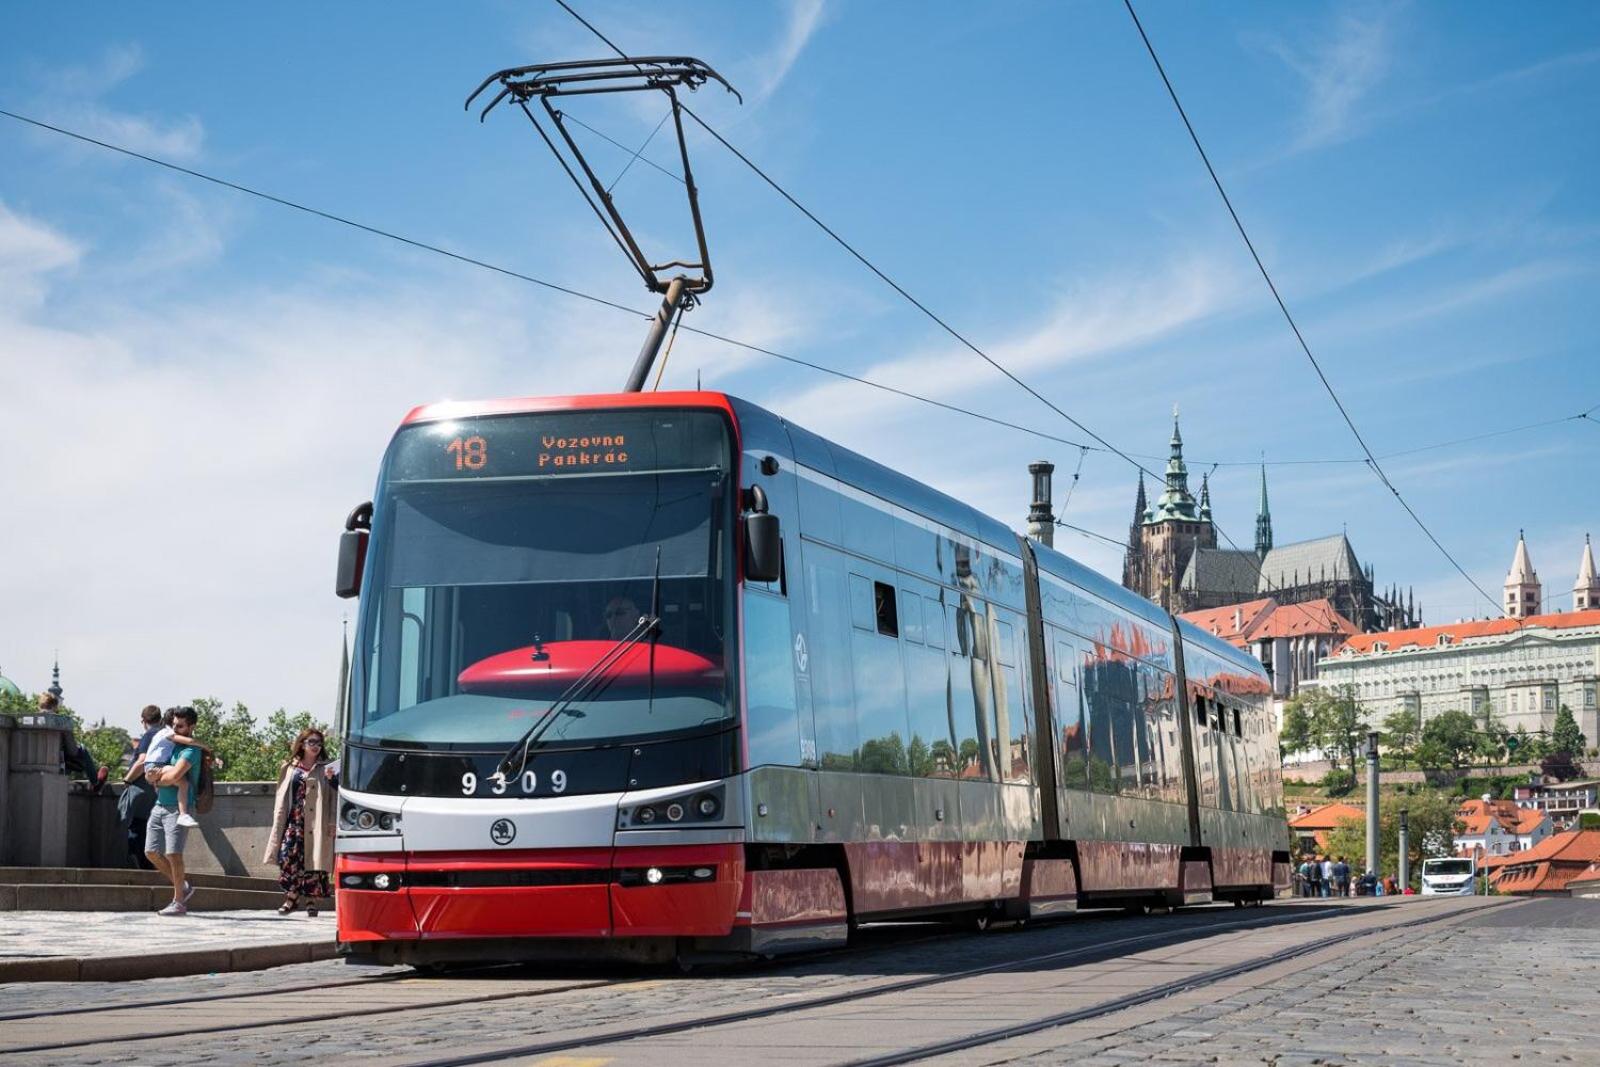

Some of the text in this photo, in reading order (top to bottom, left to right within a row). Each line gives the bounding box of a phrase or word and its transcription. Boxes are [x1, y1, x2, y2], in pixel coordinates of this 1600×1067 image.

[542, 435, 625, 449] Vozovna
[447, 436, 487, 470] 18
[538, 449, 628, 466] Pankrác
[462, 770, 567, 795] 9309
